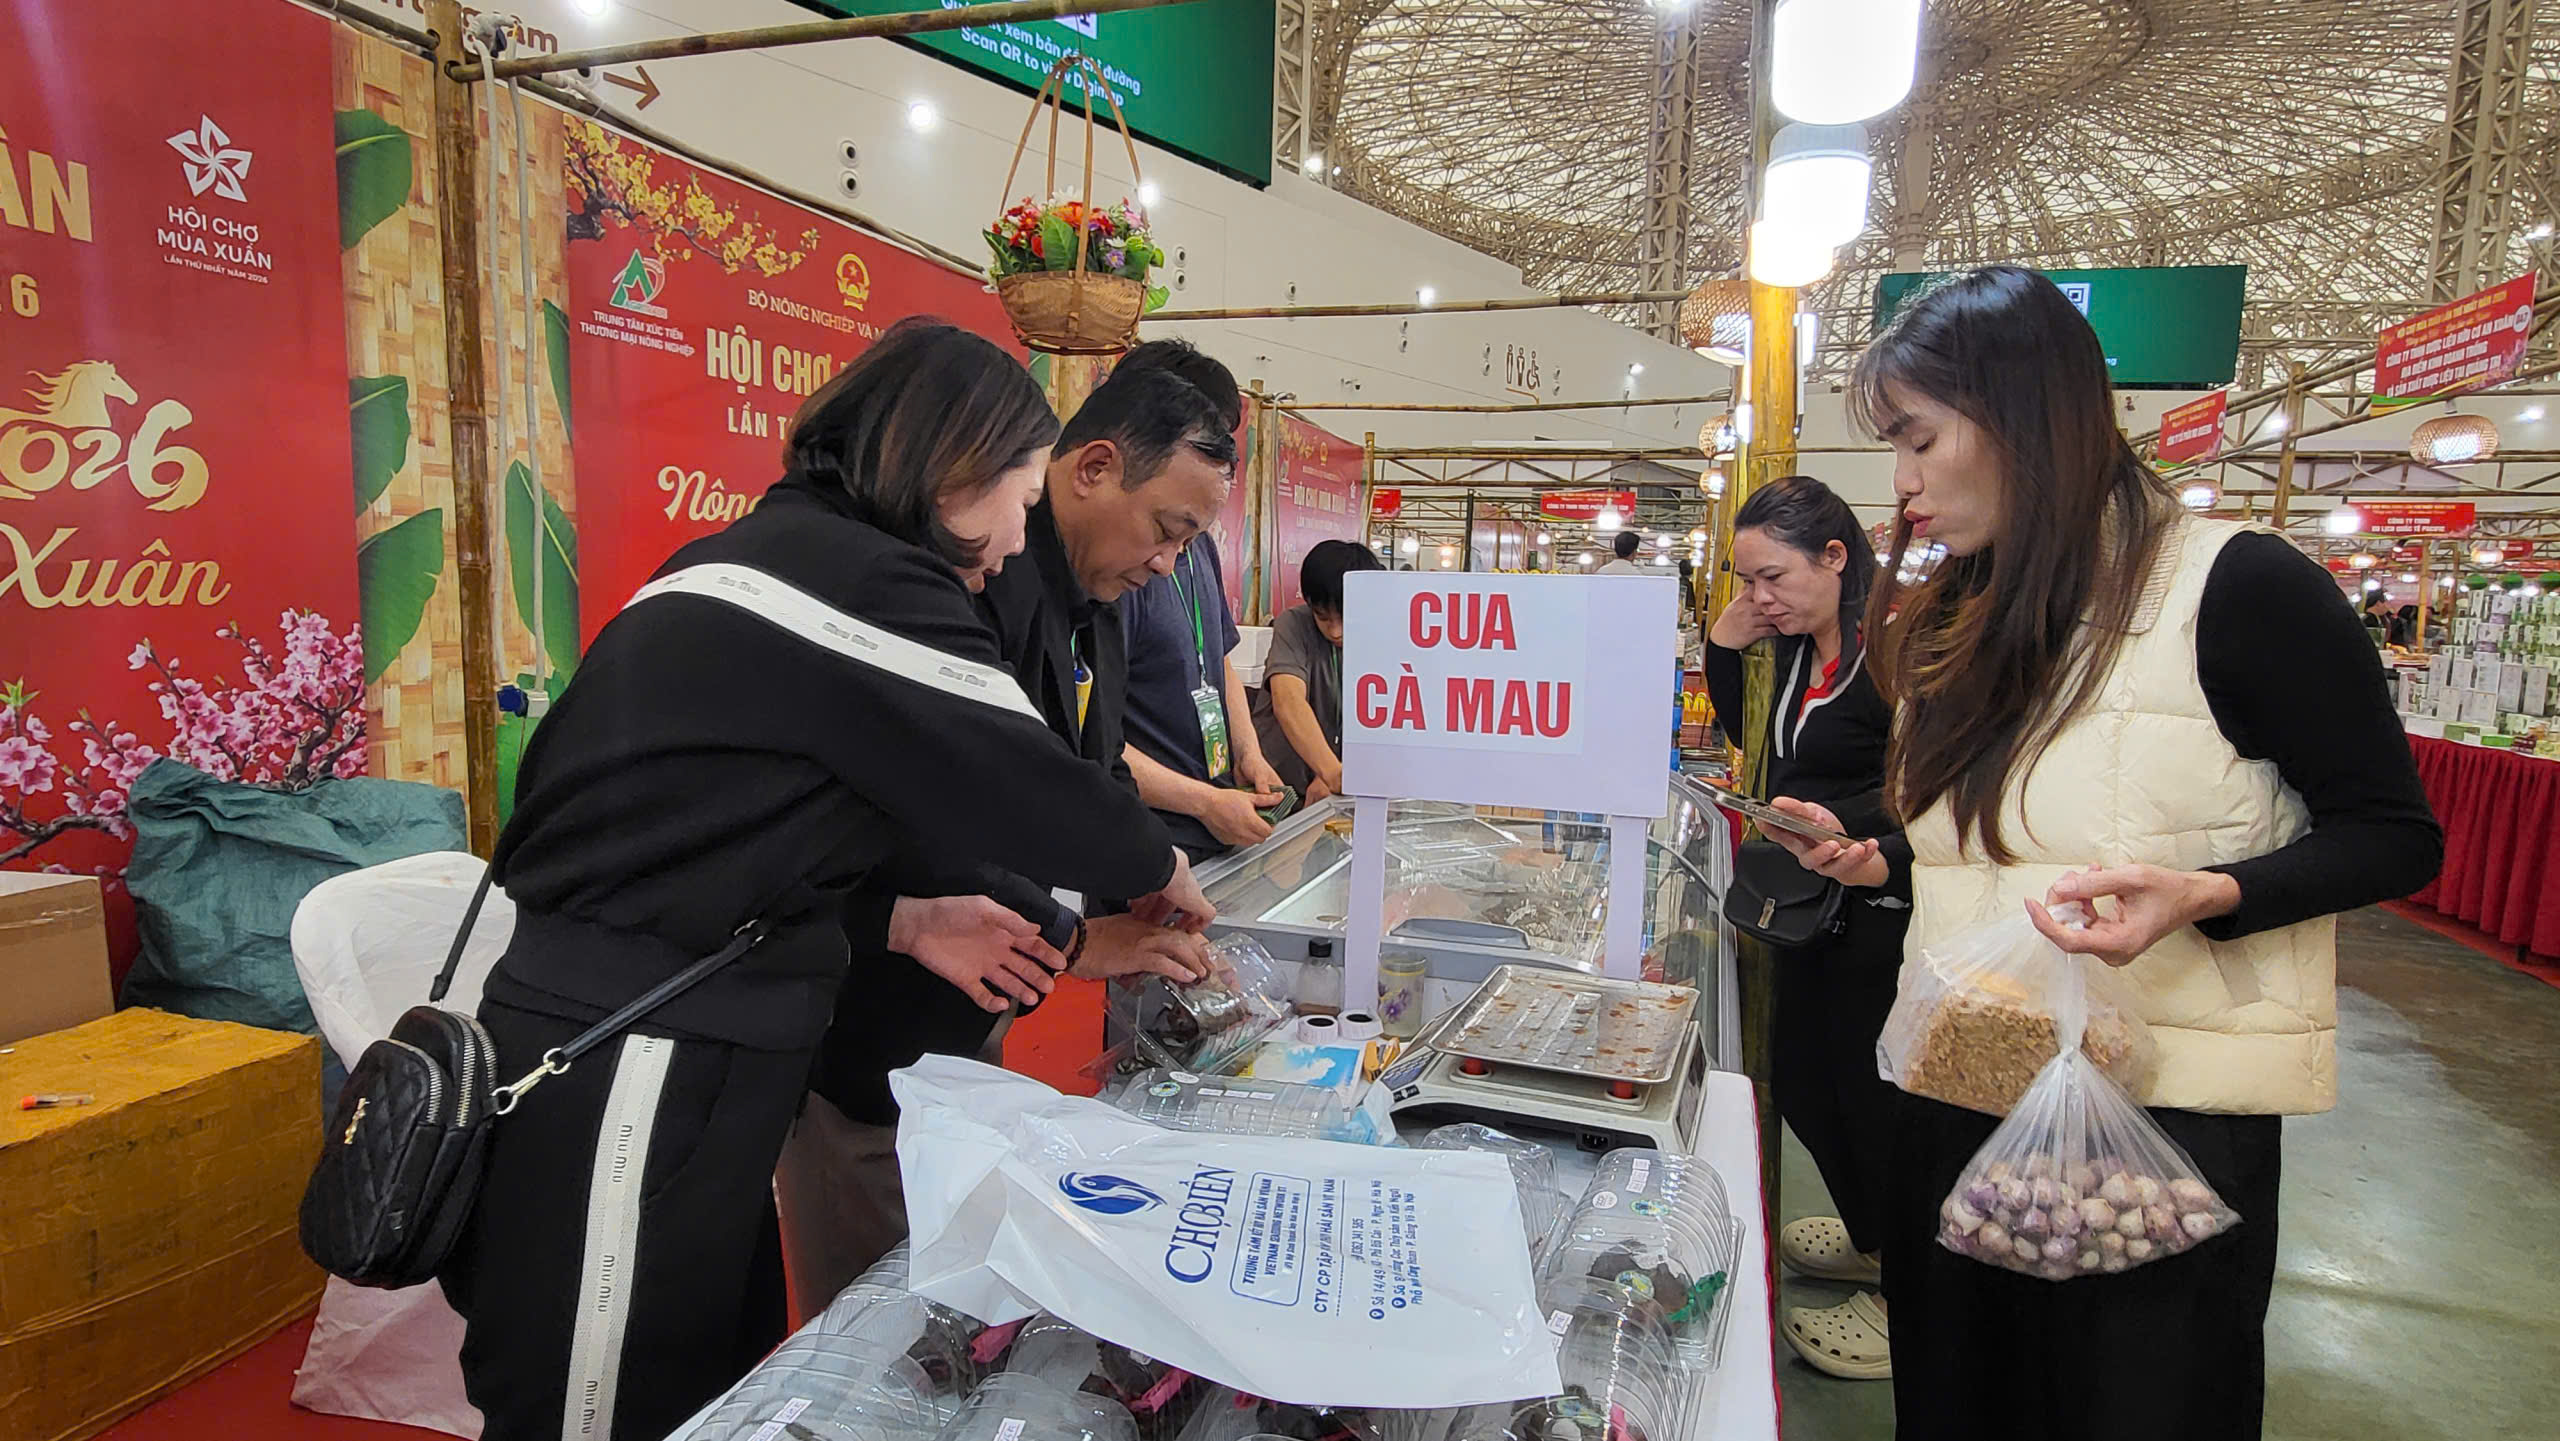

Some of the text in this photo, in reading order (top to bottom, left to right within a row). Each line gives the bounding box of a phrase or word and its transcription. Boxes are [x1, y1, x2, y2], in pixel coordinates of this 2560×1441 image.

[960, 25, 999, 55] Scan
[1000, 41, 1022, 64] QR
[1024, 51, 1040, 71] to
[1004, 21, 1034, 46] xem
[1035, 32, 1061, 57] bản
[1103, 64, 1141, 96] đường
[168, 205, 259, 246] HỘI CHỢ
[157, 228, 272, 270] MÙA XUÂN
[592, 310, 625, 328] TRUNG
[625, 318, 645, 332] TÂM
[646, 322, 664, 337] XÚC
[747, 289, 768, 311] BỘ
[769, 296, 809, 321] NÔNG
[810, 308, 855, 333] NGHIỆP
[580, 321, 620, 340] THƯƠNG
[620, 331, 638, 345] MẠI
[639, 335, 664, 350] NÔNG
[706, 324, 763, 395] HỘI
[727, 401, 768, 438] LẦN
[1409, 591, 1517, 651] CUA
[1355, 663, 1572, 739] CÀ MAU
[1322, 1178, 1335, 1193] NAM
[1317, 1203, 1335, 1218] SẢN
[1316, 1220, 1333, 1233] HẢI
[1247, 1237, 1262, 1253] TÂM
[1264, 1243, 1280, 1276] VIETNAM
[1316, 1251, 1336, 1268] TẬP
[1242, 1254, 1259, 1284] TRUNG
[1317, 1270, 1331, 1286] CP
[1373, 1269, 1386, 1294] 14/49
[1313, 1288, 1329, 1313] CTY
